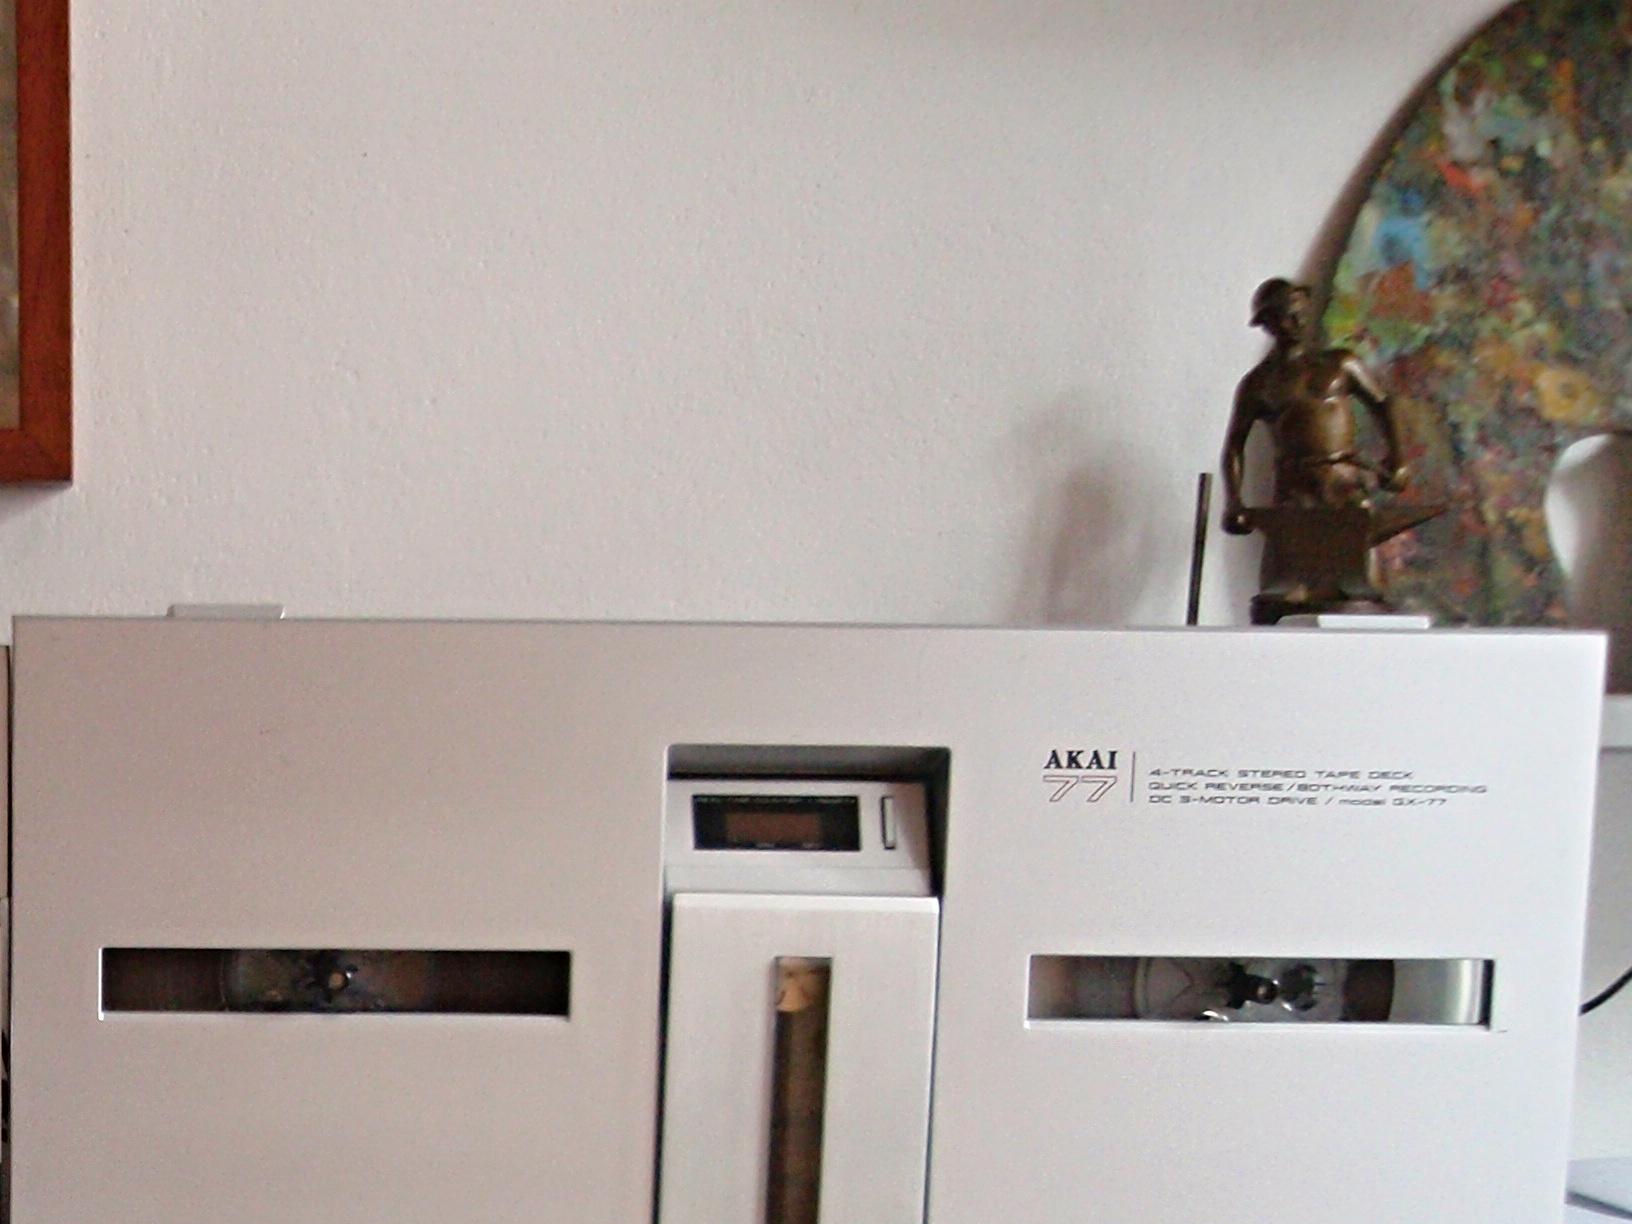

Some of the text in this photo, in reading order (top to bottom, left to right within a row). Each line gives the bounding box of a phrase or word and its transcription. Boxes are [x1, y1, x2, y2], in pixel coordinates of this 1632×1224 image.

[1043, 750, 1117, 769] AKAI
[1149, 769, 1413, 780] 4-TRACK STEREO TAPE DECK
[1043, 776, 1117, 802] 77
[1149, 782, 1199, 792] QUICK
[1389, 784, 1488, 794] RECORDING
[1149, 795, 1172, 805] DC
[1180, 795, 1260, 805] 3-MOTOR
[1268, 796, 1317, 806] DRIVE
